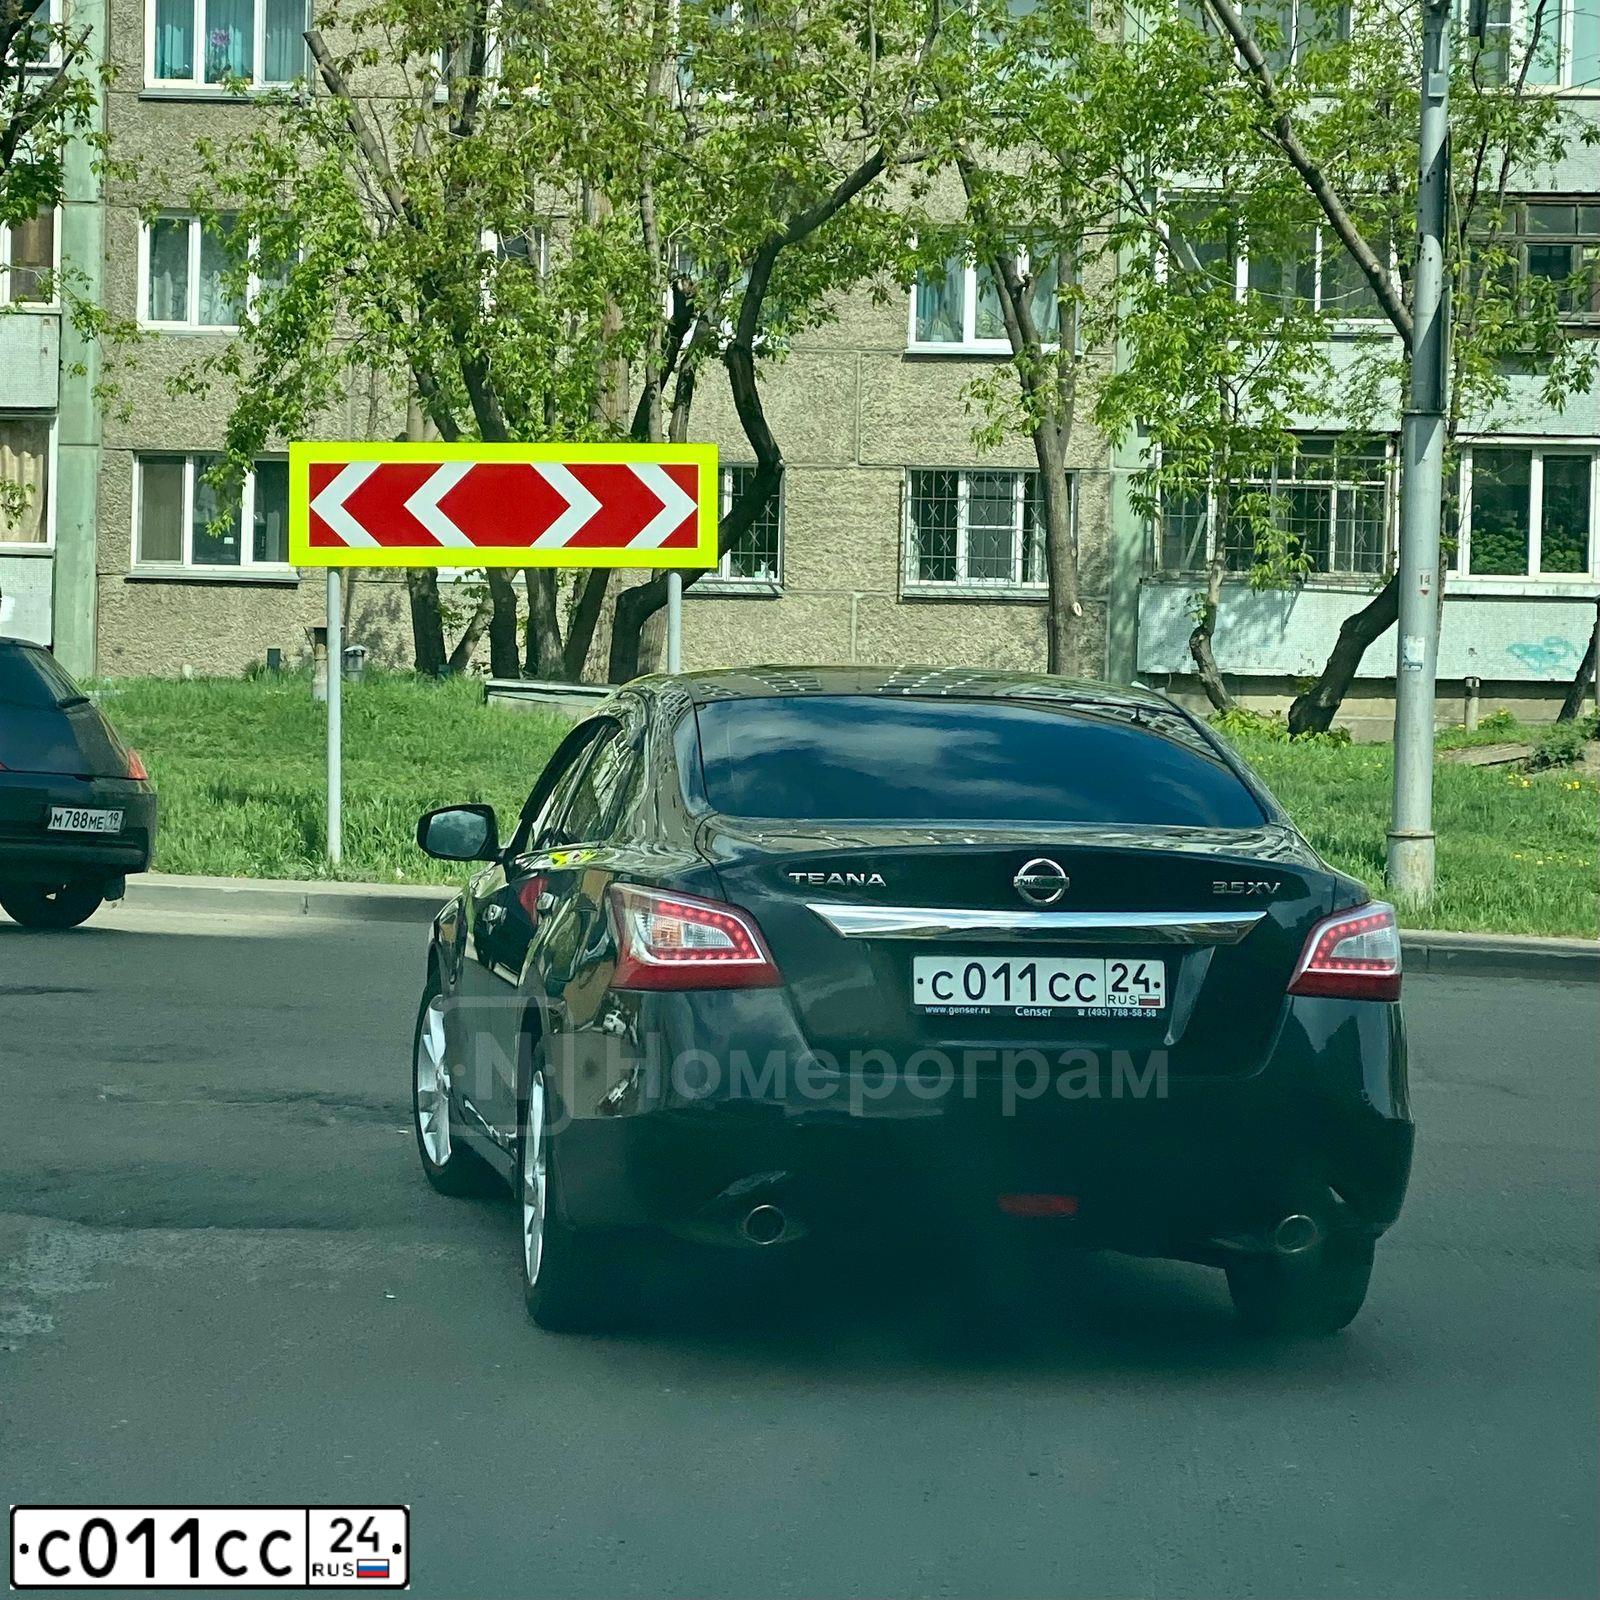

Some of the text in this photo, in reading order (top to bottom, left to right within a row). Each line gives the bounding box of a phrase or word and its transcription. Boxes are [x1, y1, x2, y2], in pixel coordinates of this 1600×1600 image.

[788, 872, 887, 887] TEANA
[1111, 963, 1150, 993] 24
[1107, 994, 1138, 1006] RUS
